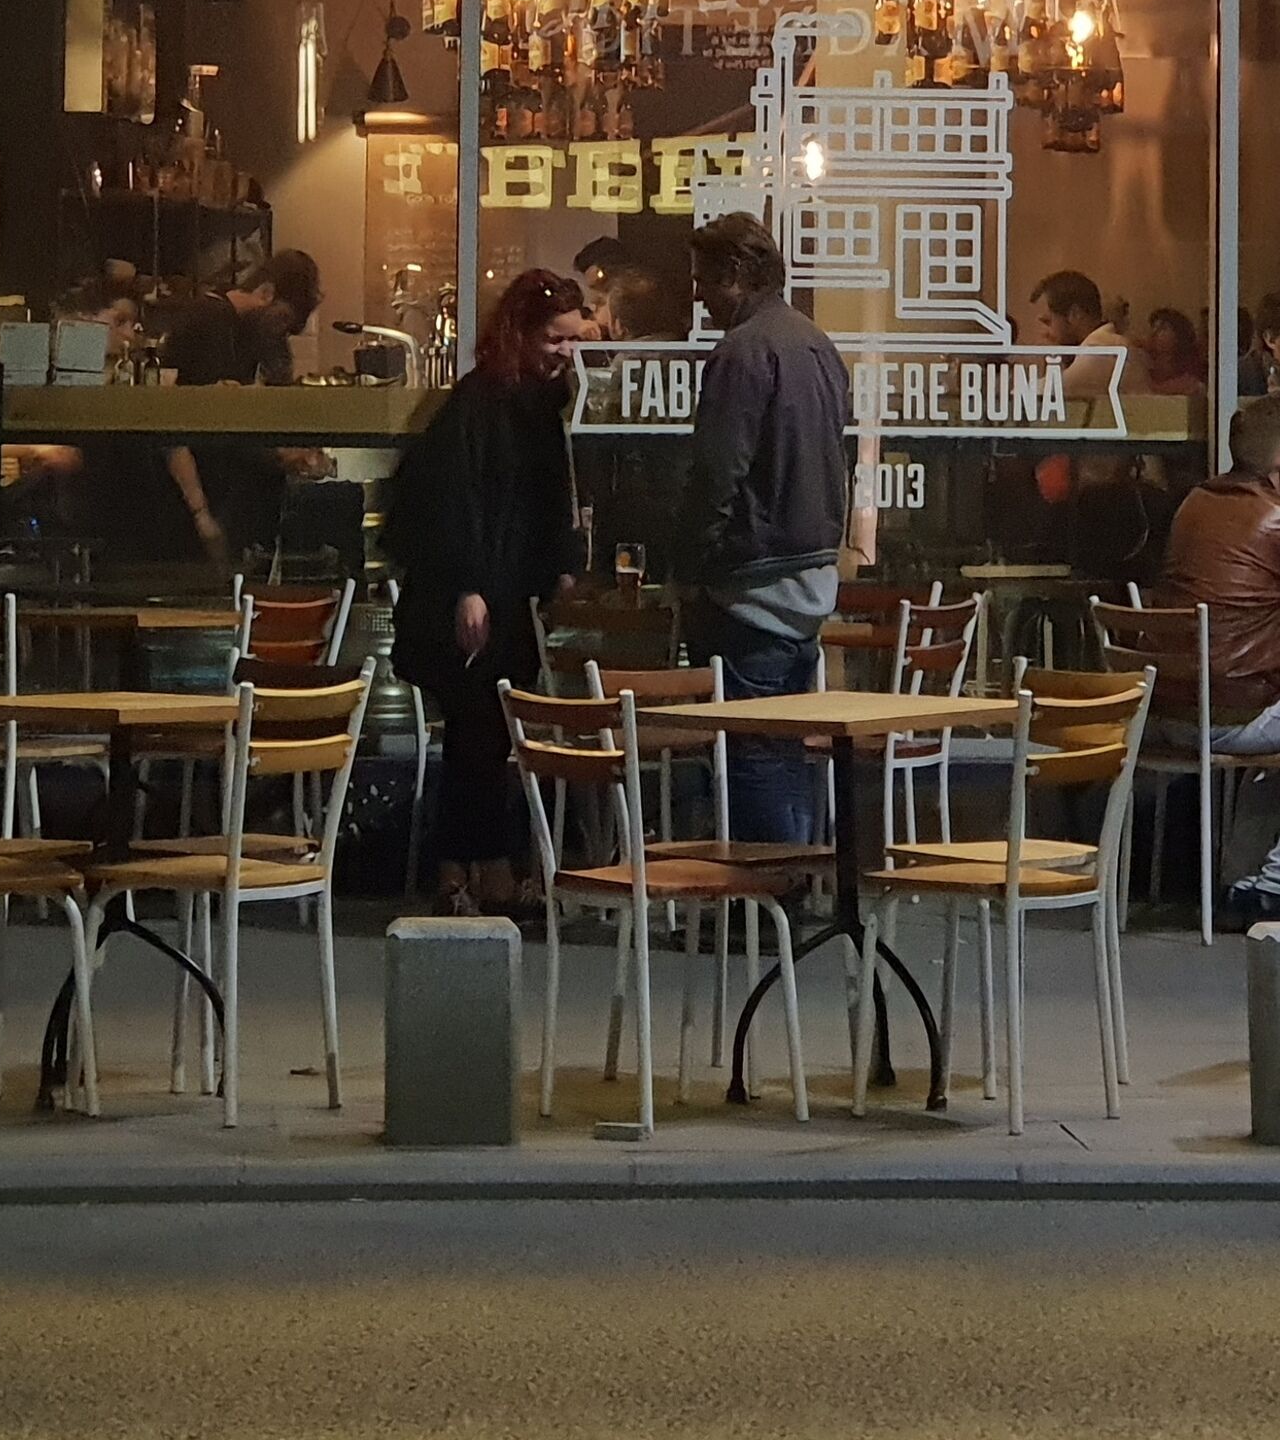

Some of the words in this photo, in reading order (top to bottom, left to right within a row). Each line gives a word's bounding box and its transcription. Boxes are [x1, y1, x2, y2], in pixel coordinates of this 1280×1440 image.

[853, 363, 950, 422] BERE
[960, 355, 1066, 422] BUNĂ
[854, 463, 926, 509] 2013
